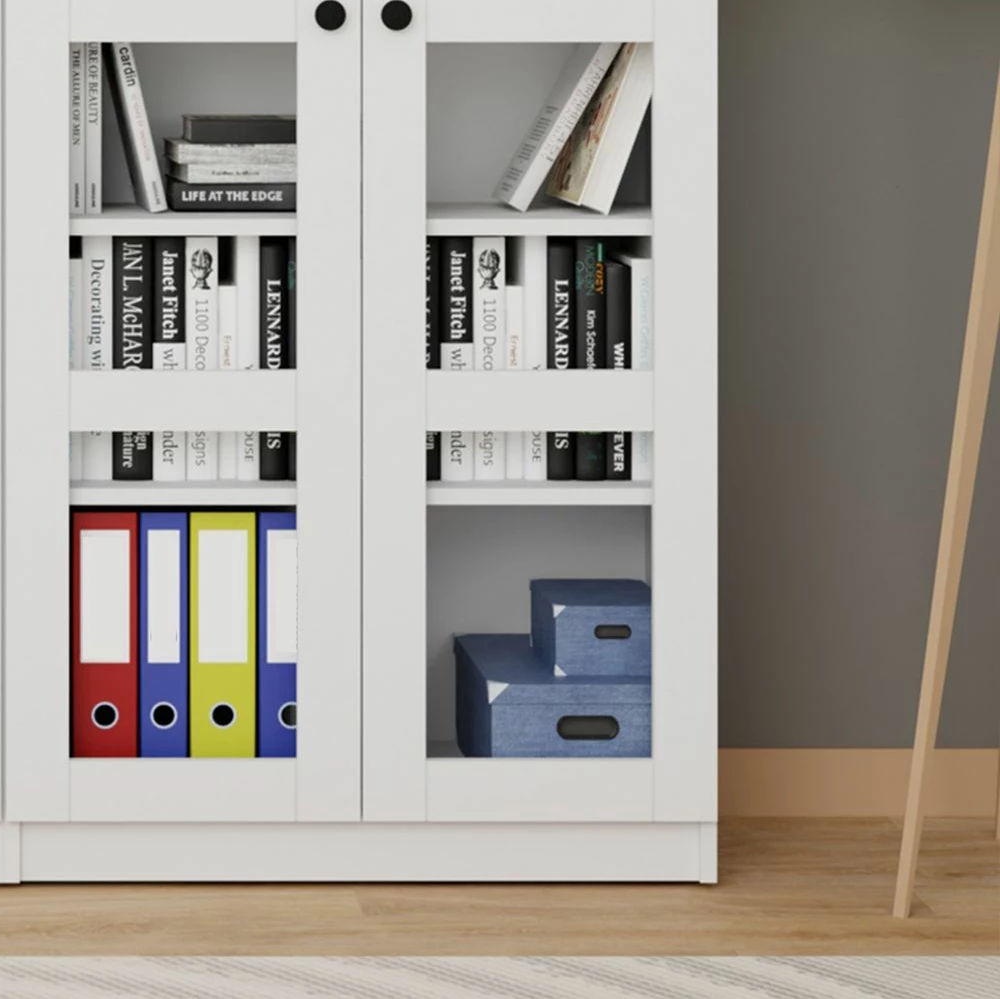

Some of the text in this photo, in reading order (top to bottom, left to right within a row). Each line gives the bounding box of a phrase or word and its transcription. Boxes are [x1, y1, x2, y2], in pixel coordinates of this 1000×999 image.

[72, 49, 81, 146] THE ALLURE OF MEN
[89, 66, 98, 125] OF BEAUTY
[119, 47, 136, 87] cardin
[181, 191, 283, 201] LIFE AT THE EDGE
[122, 242, 143, 271] JAN
[87, 259, 105, 345] Decorating
[162, 250, 178, 340] Janet Fitch
[195, 299, 209, 332] 1100
[267, 279, 281, 369] LENNARD
[450, 250, 466, 340] Janet Fitch
[483, 299, 497, 332] 1100
[554, 279, 569, 369] LENNARD
